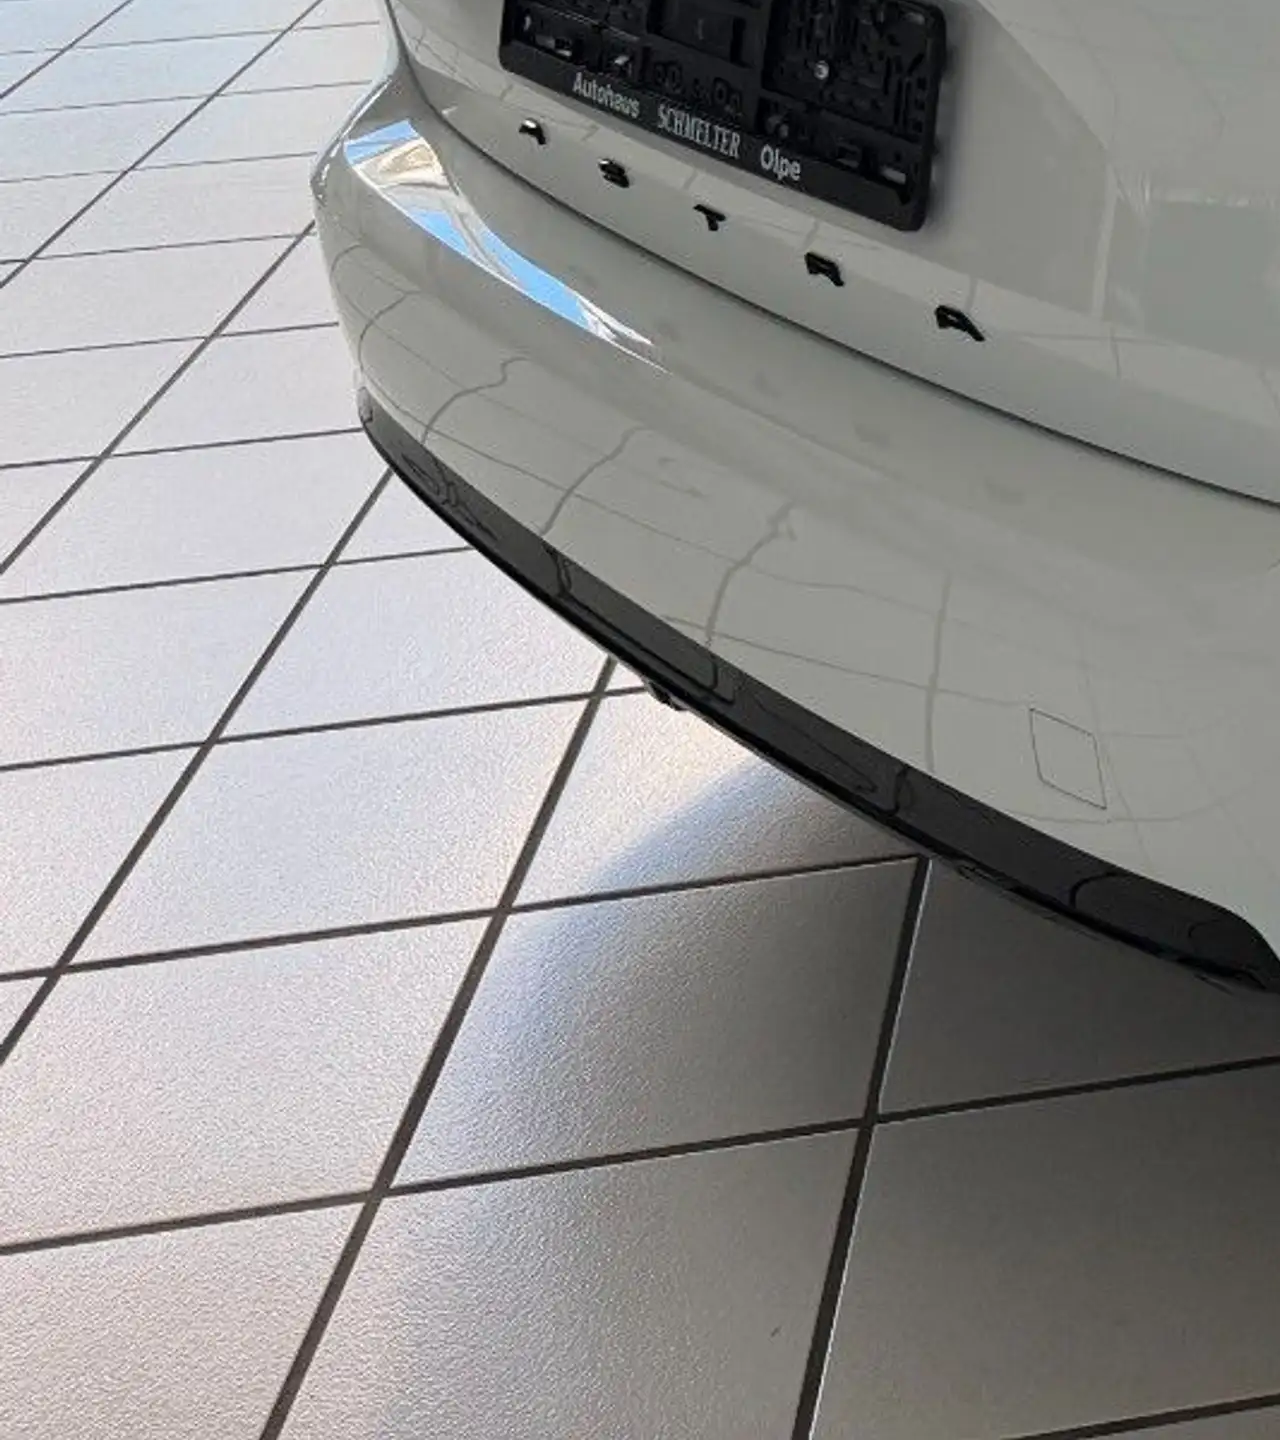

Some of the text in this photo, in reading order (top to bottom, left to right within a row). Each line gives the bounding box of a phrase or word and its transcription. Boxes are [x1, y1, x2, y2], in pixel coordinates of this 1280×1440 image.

[572, 71, 801, 181] Autohaus SCHMELTER Olpe
[518, 116, 985, 342] ASTRA
